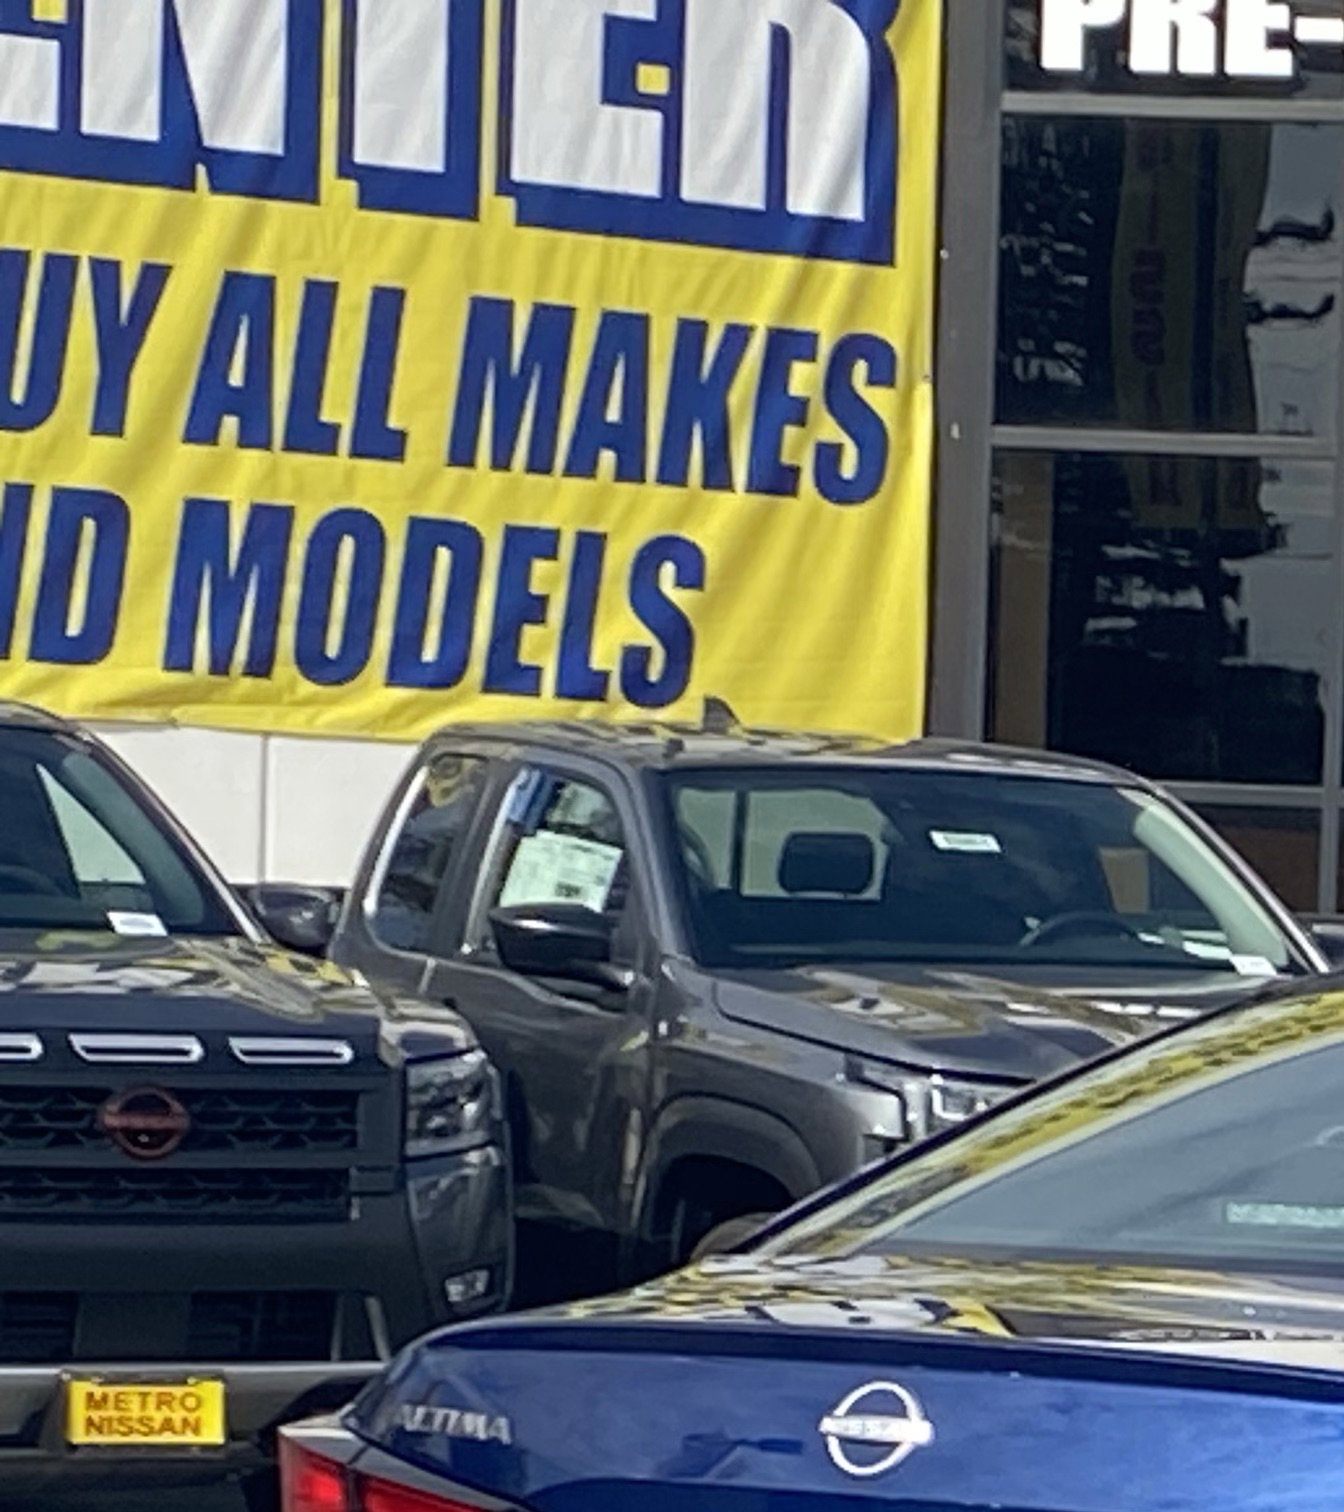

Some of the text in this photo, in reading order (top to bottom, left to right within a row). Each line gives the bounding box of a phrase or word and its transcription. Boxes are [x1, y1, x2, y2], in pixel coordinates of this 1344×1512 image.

[183, 271, 408, 463] ALL
[447, 295, 897, 506] MAKES
[163, 498, 706, 708] MODELS
[84, 1391, 203, 1414] METRO
[84, 1414, 203, 1438] NISSAN
